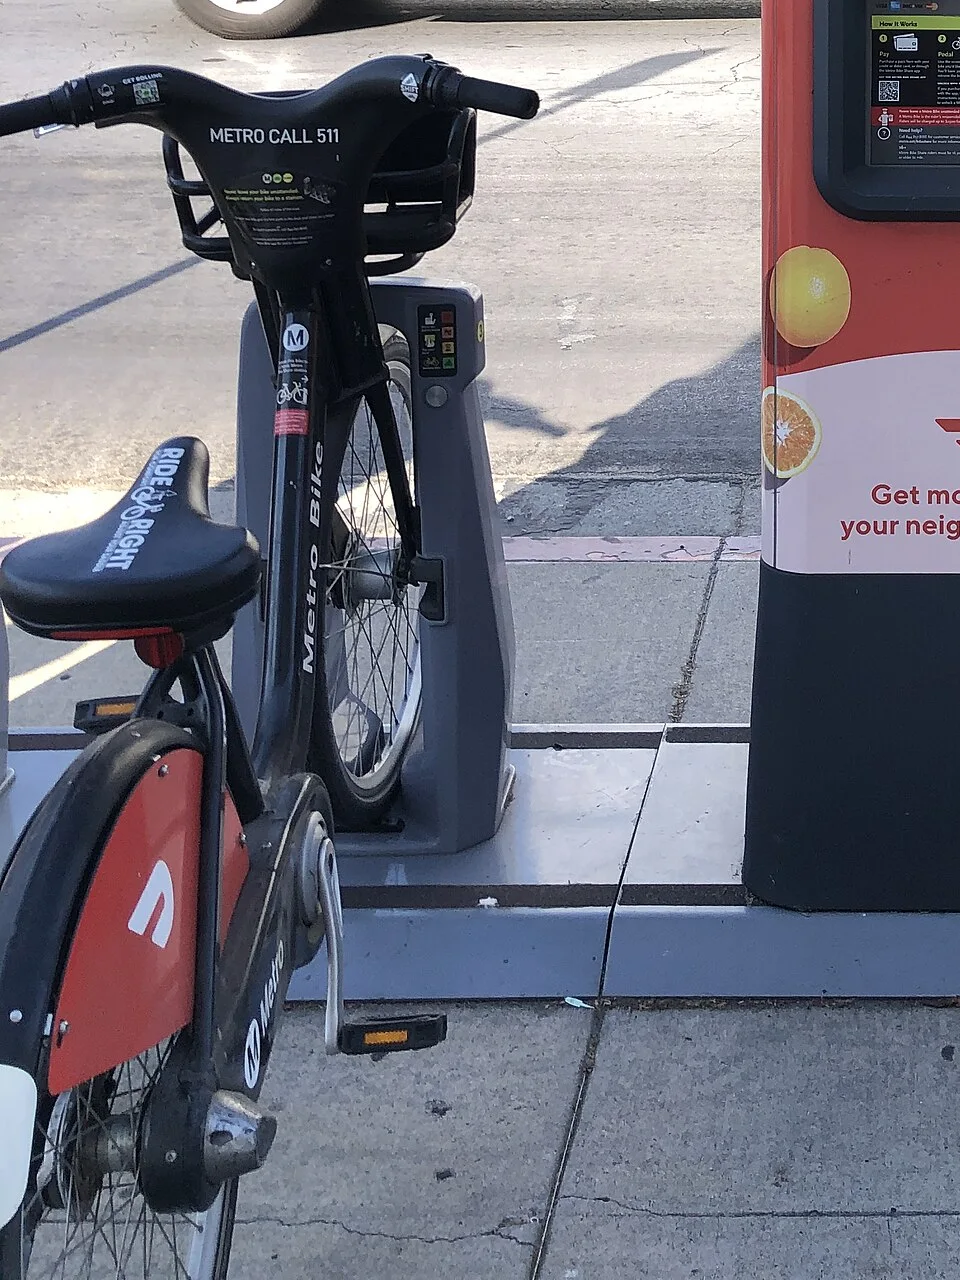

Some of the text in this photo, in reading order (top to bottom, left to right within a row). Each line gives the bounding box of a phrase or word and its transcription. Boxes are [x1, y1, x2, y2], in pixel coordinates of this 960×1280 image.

[210, 127, 340, 144] METRO CALL 511
[150, 447, 185, 486] RIDE
[870, 484, 920, 505] Get
[105, 518, 154, 570] RIGHT
[840, 519, 900, 541] your
[302, 440, 323, 674] Metro Bike
[260, 939, 284, 1037] Metro
